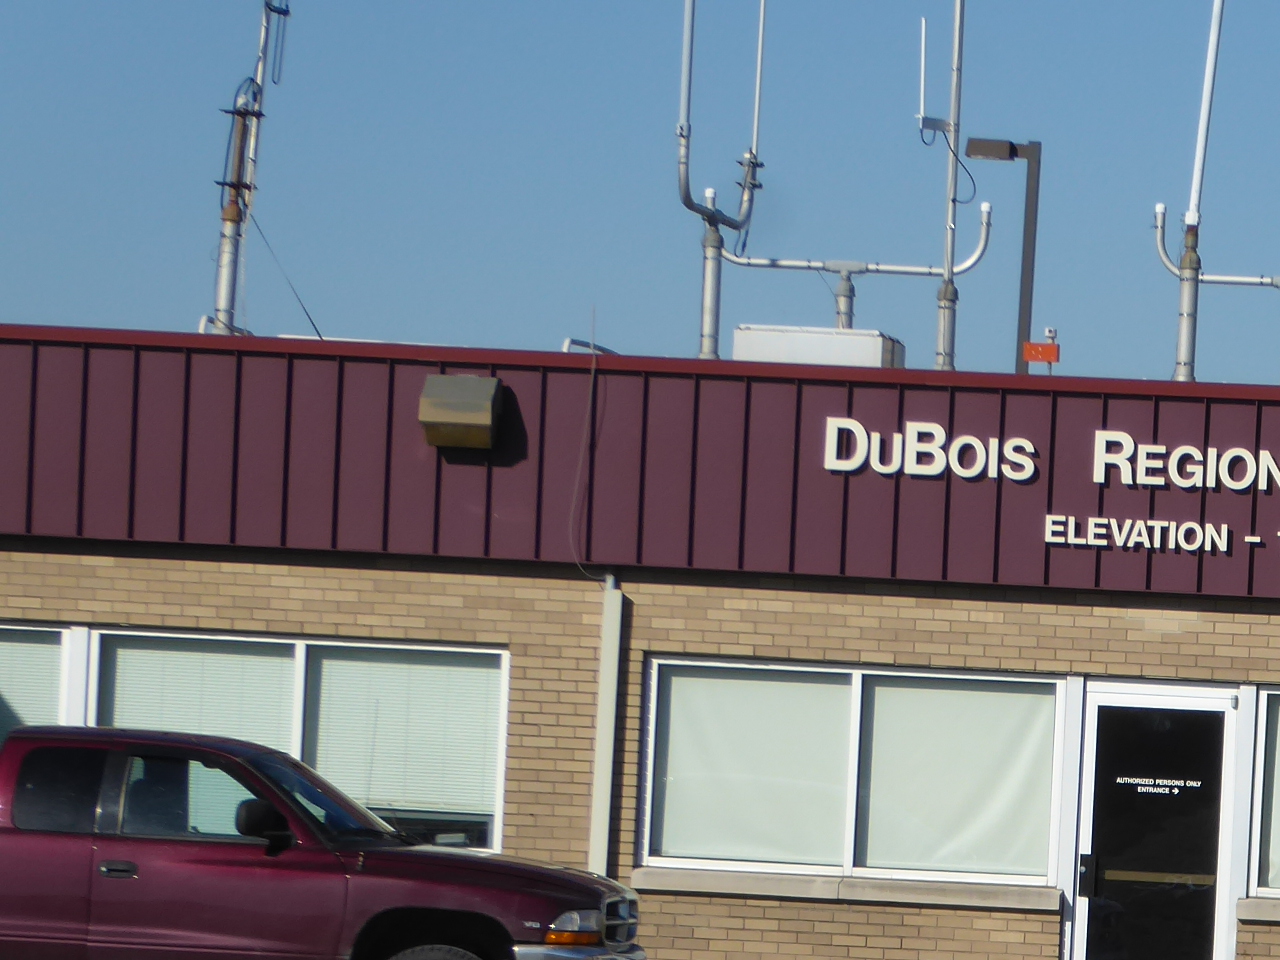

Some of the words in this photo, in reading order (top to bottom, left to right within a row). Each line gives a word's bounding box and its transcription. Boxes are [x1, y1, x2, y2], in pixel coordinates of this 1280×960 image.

[1044, 514, 1229, 552] ELEVATION
[1116, 777, 1154, 785] AUTHORIZED
[1155, 778, 1185, 787] PERSONS
[1186, 780, 1202, 788] ONLY
[1137, 786, 1170, 794] ENTRANCE
